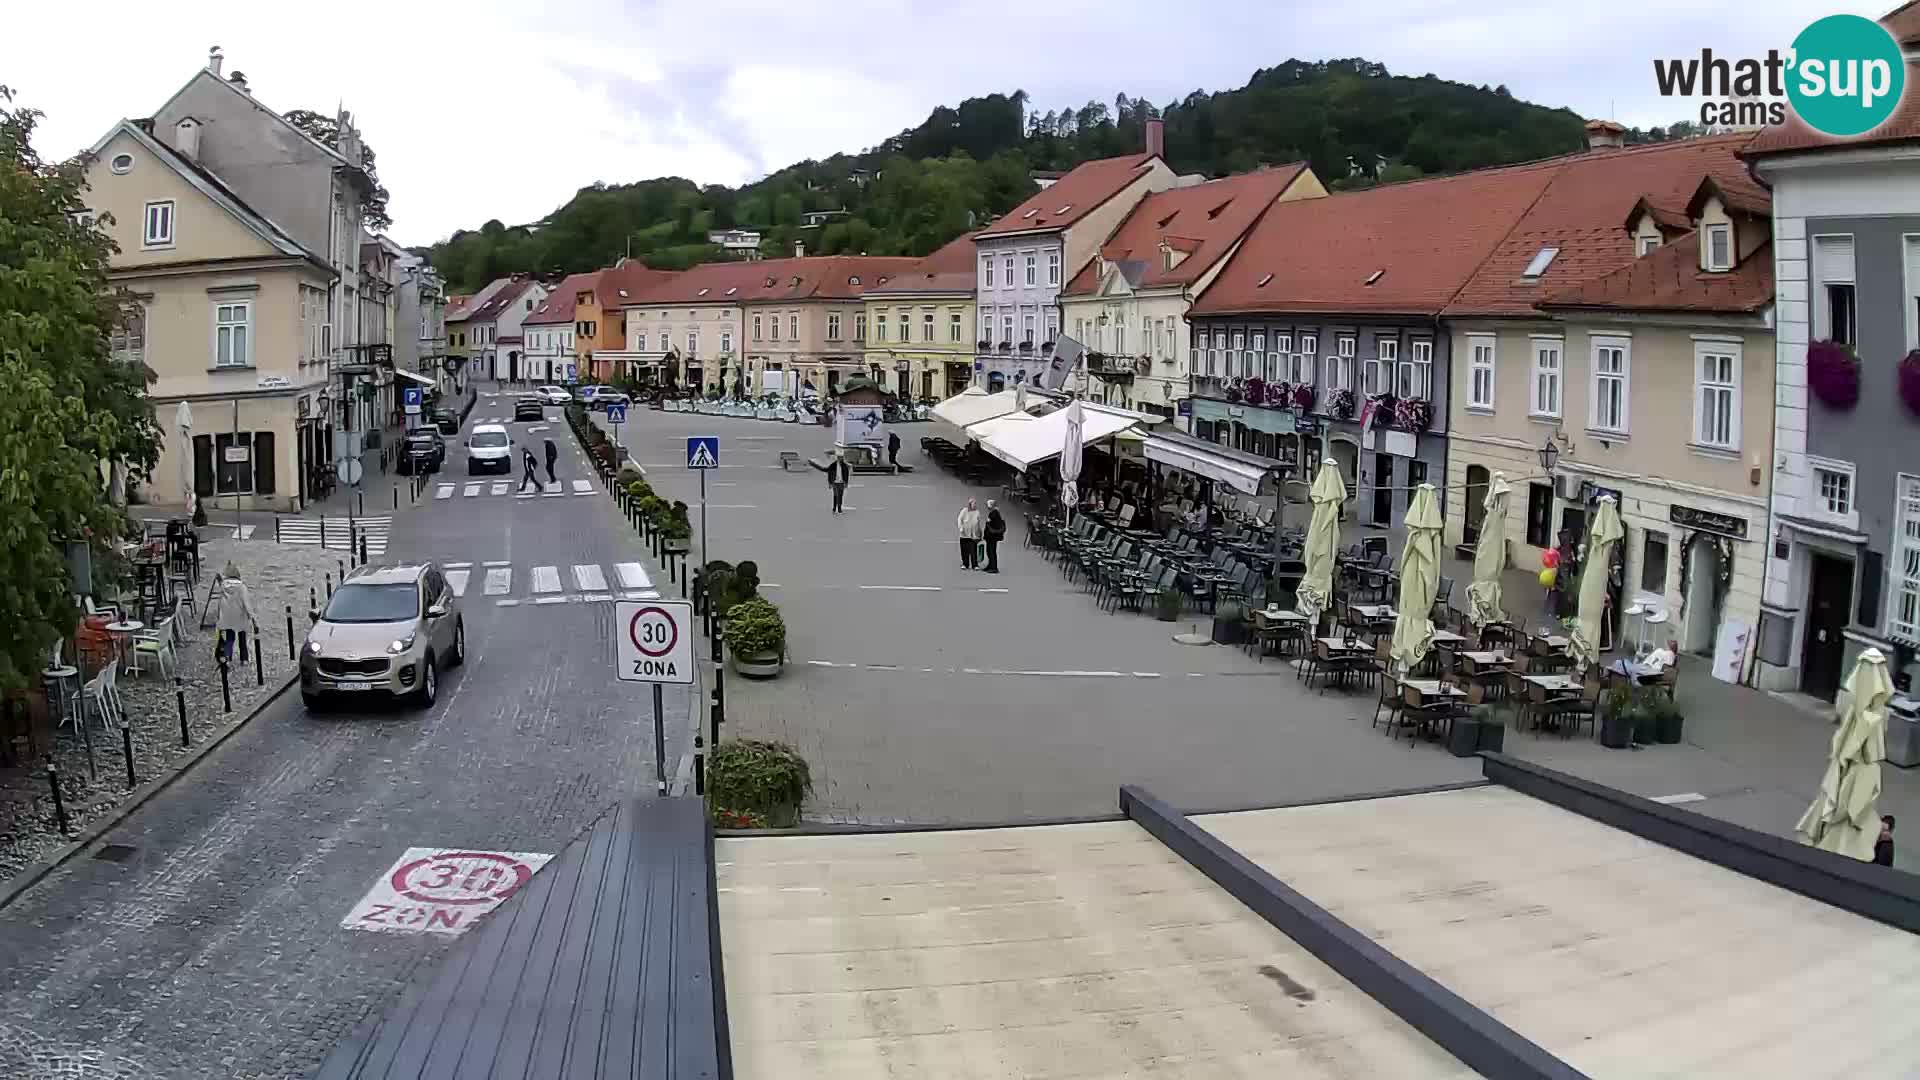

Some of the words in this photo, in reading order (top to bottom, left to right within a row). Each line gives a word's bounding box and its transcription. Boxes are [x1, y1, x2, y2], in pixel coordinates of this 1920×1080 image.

[409, 392, 417, 403] P
[642, 622, 667, 644] 30
[633, 659, 677, 677] ZONA
[418, 864, 504, 893] 30
[361, 903, 471, 930] ZON
